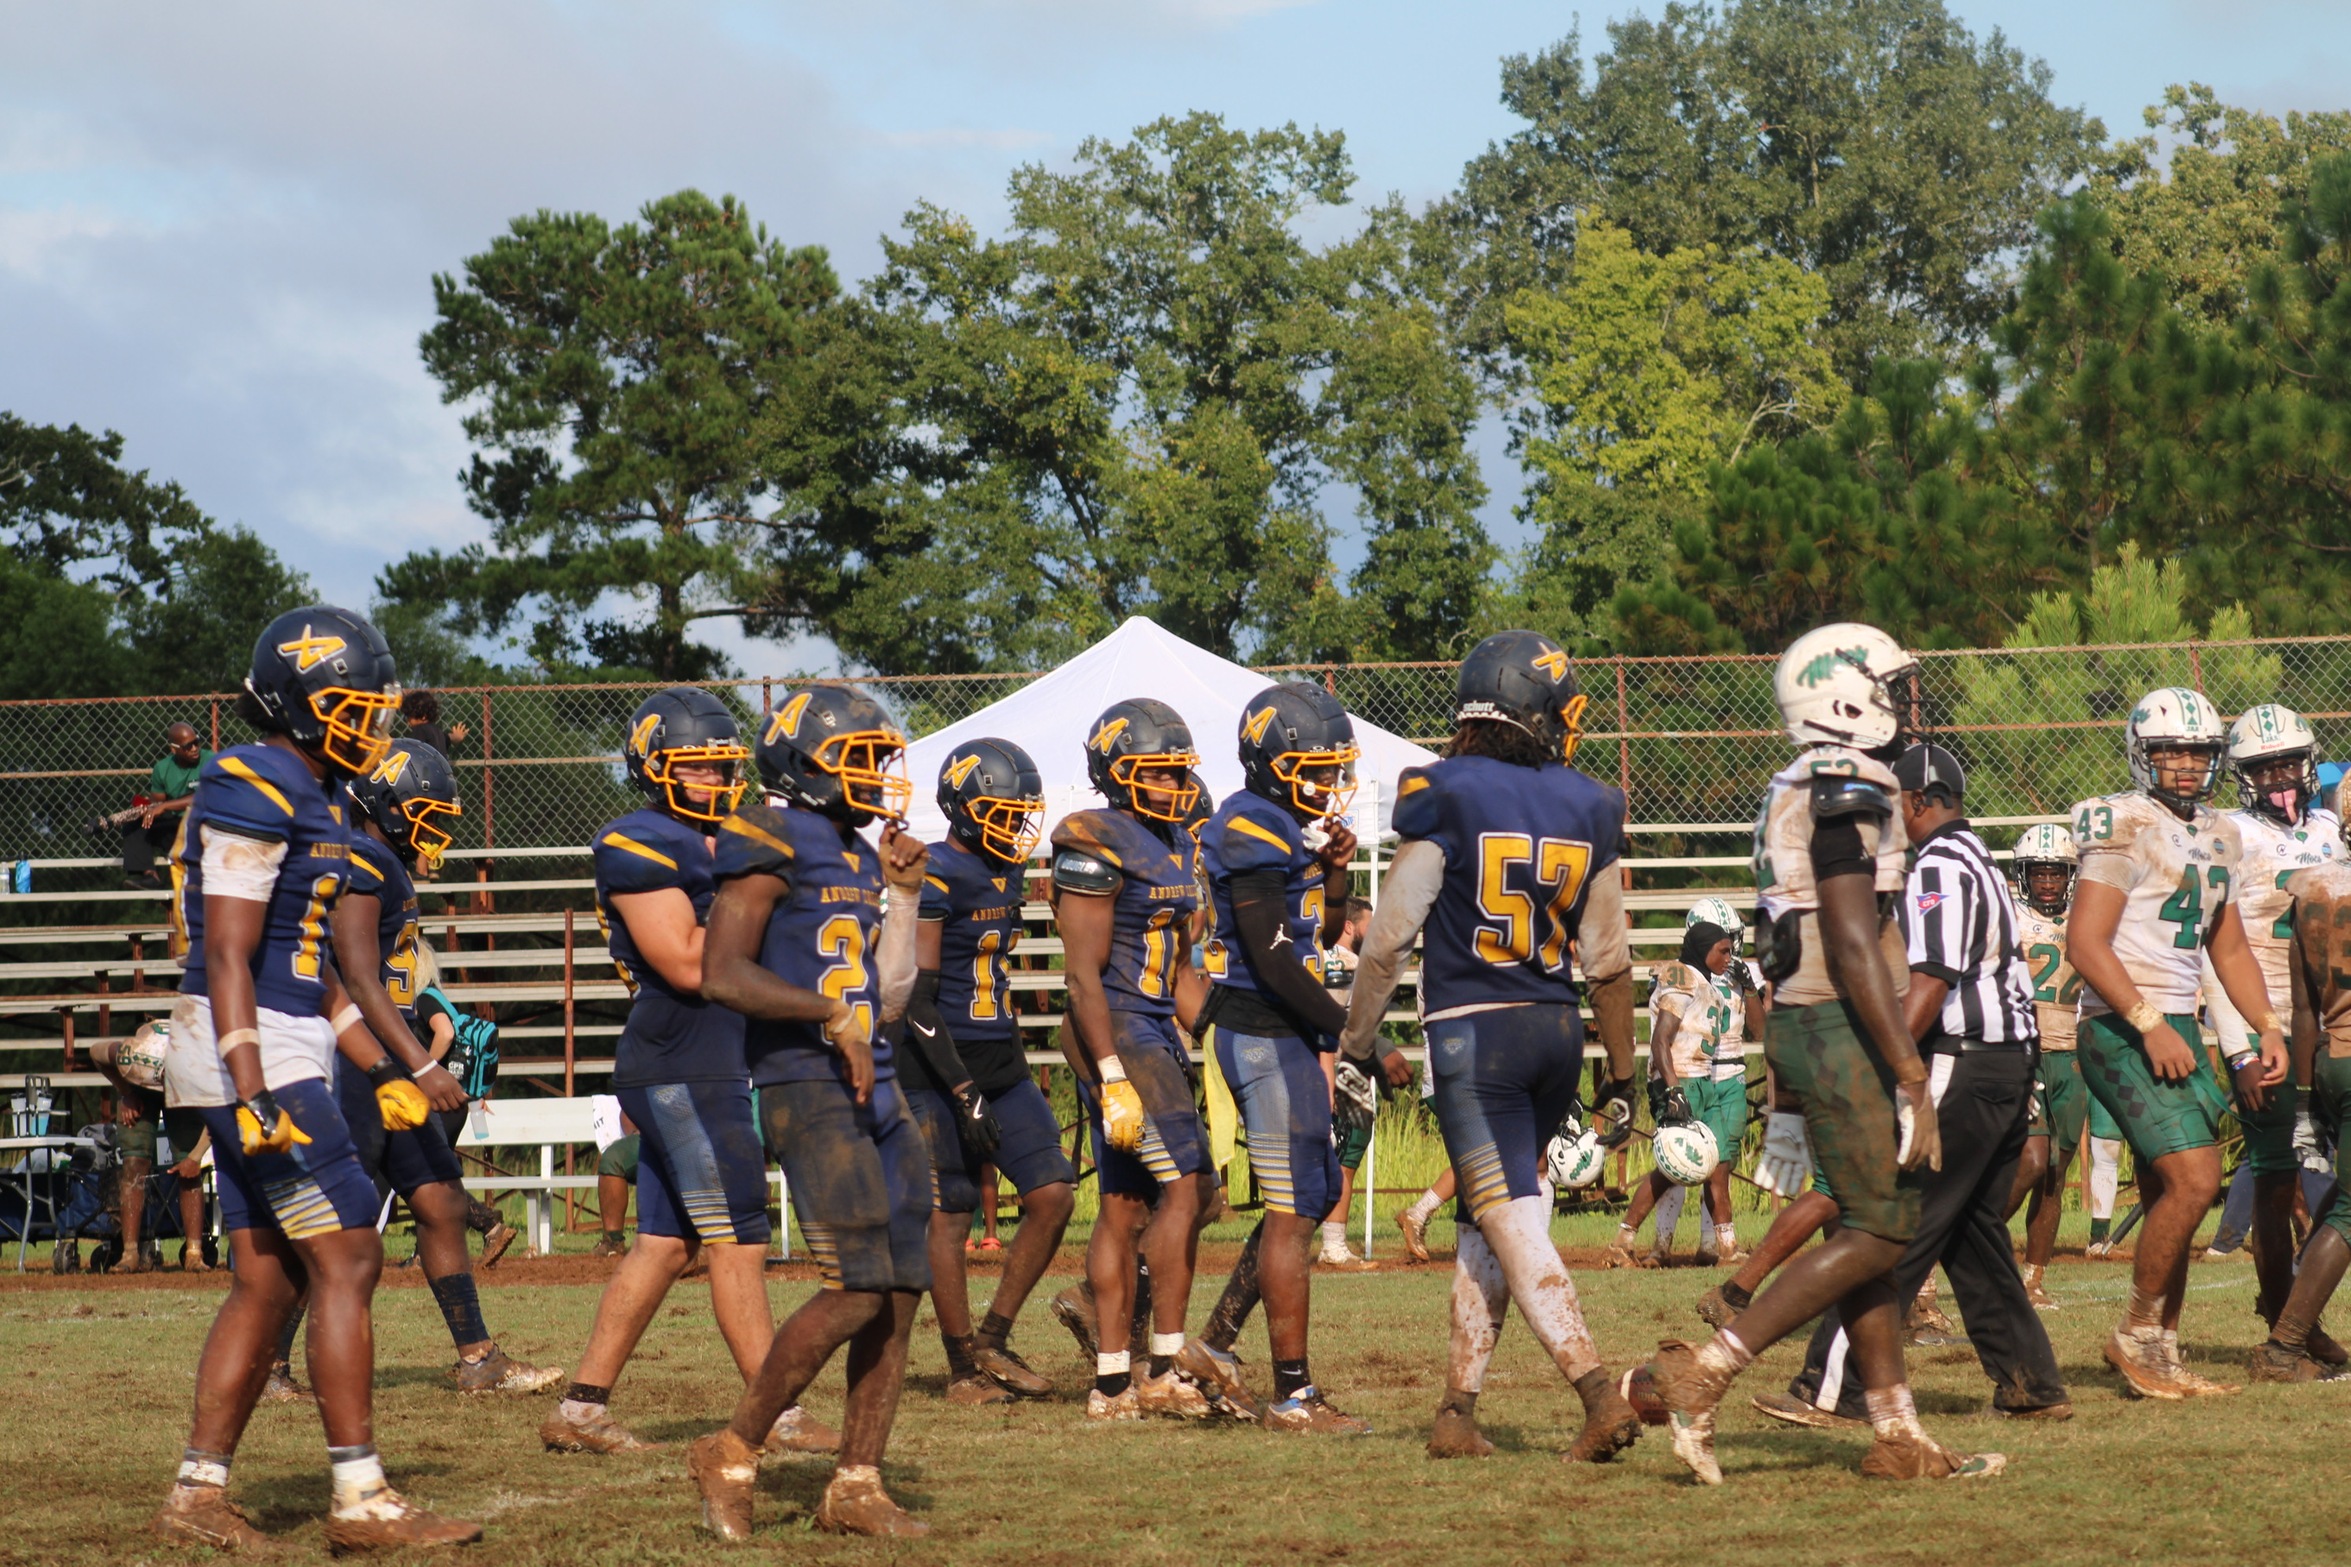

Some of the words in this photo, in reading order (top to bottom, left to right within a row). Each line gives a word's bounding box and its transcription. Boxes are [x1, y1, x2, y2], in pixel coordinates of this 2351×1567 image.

[1463, 700, 1495, 712] schutt
[2078, 807, 2113, 842] 43
[2188, 847, 2212, 862] Mocs
[2295, 852, 2322, 864] Mocs
[821, 886, 860, 904] ANDREW
[1149, 885, 1185, 899] ANDREW
[1472, 828, 1593, 974] 57
[972, 907, 1006, 921] ANDREW
[1667, 966, 1686, 986] 31
